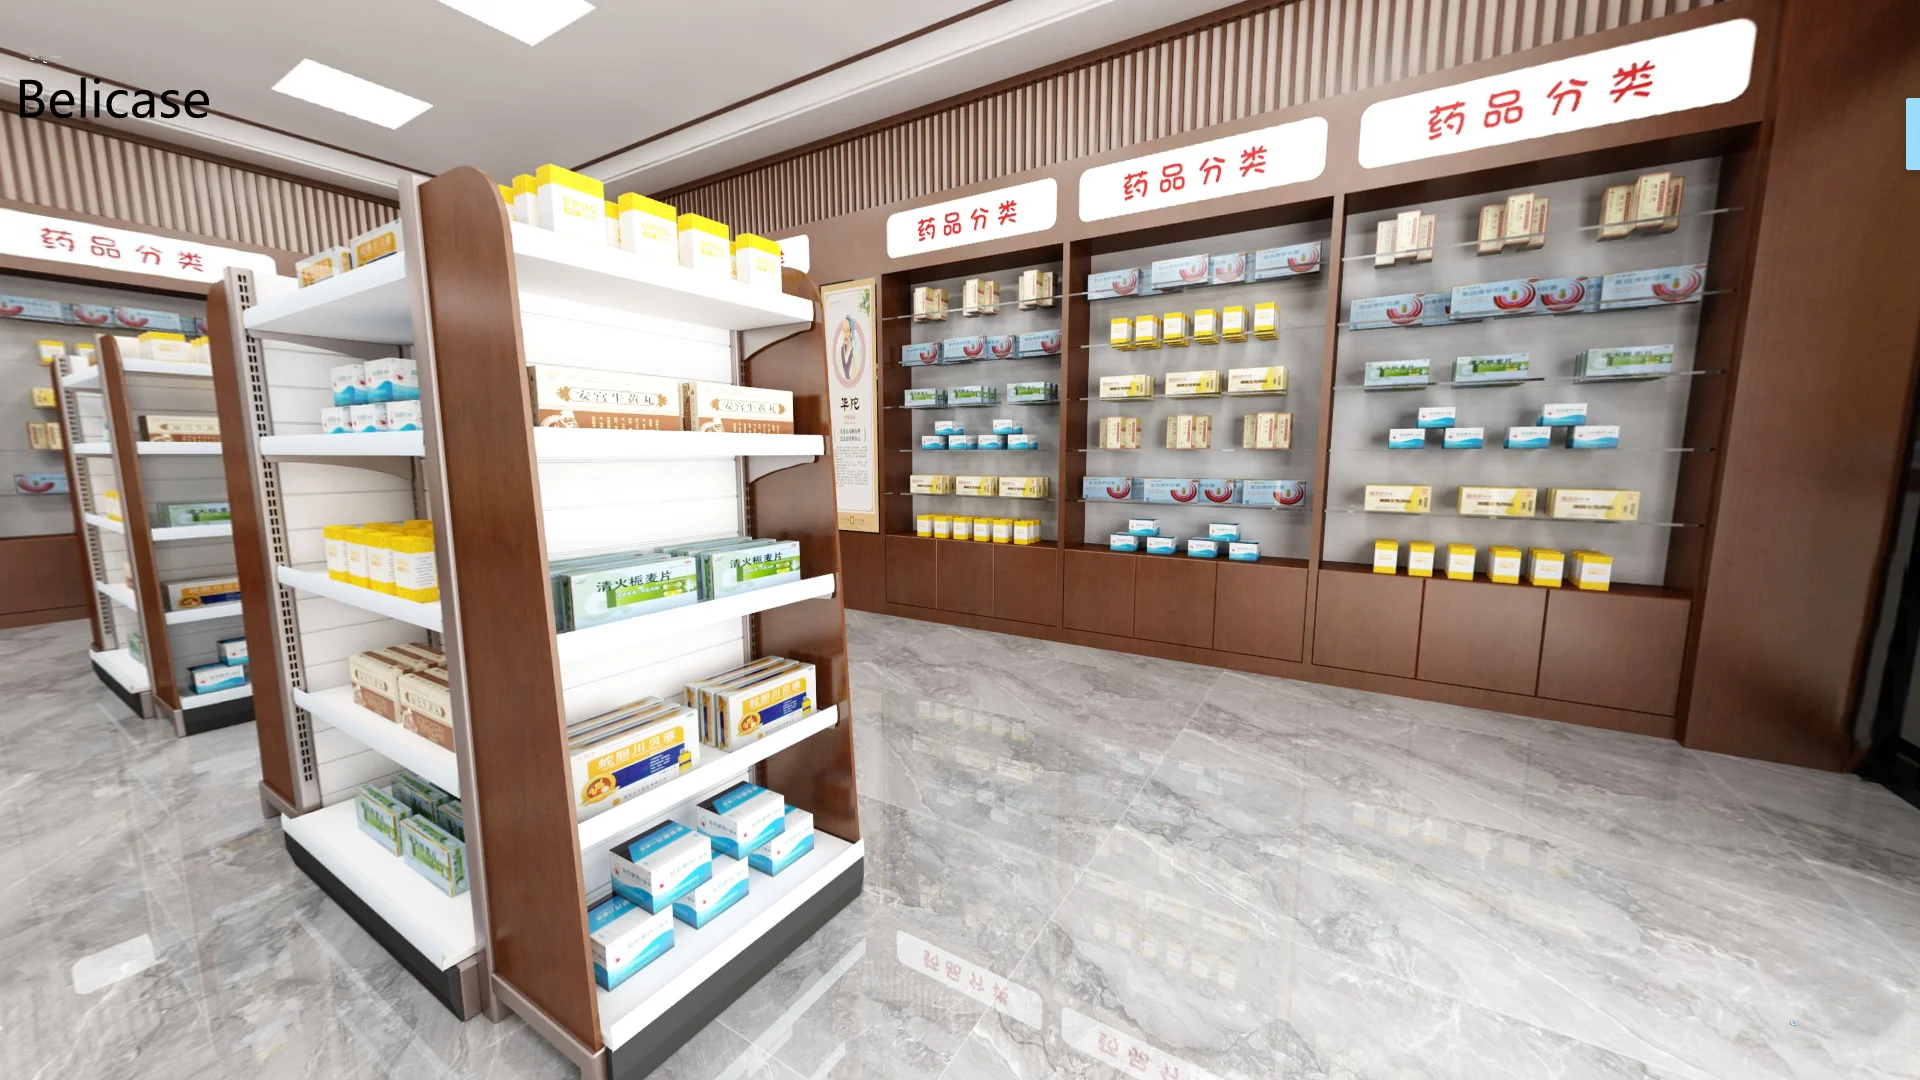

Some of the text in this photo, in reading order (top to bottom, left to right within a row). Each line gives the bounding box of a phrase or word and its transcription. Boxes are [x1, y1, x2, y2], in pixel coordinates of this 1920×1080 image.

[1429, 60, 1655, 140] 药品分类
[1124, 147, 1268, 201] 药品分类
[917, 200, 1018, 242] 药品分类
[40, 228, 204, 272] 药品分类
[596, 570, 672, 593] 清火栀麦片
